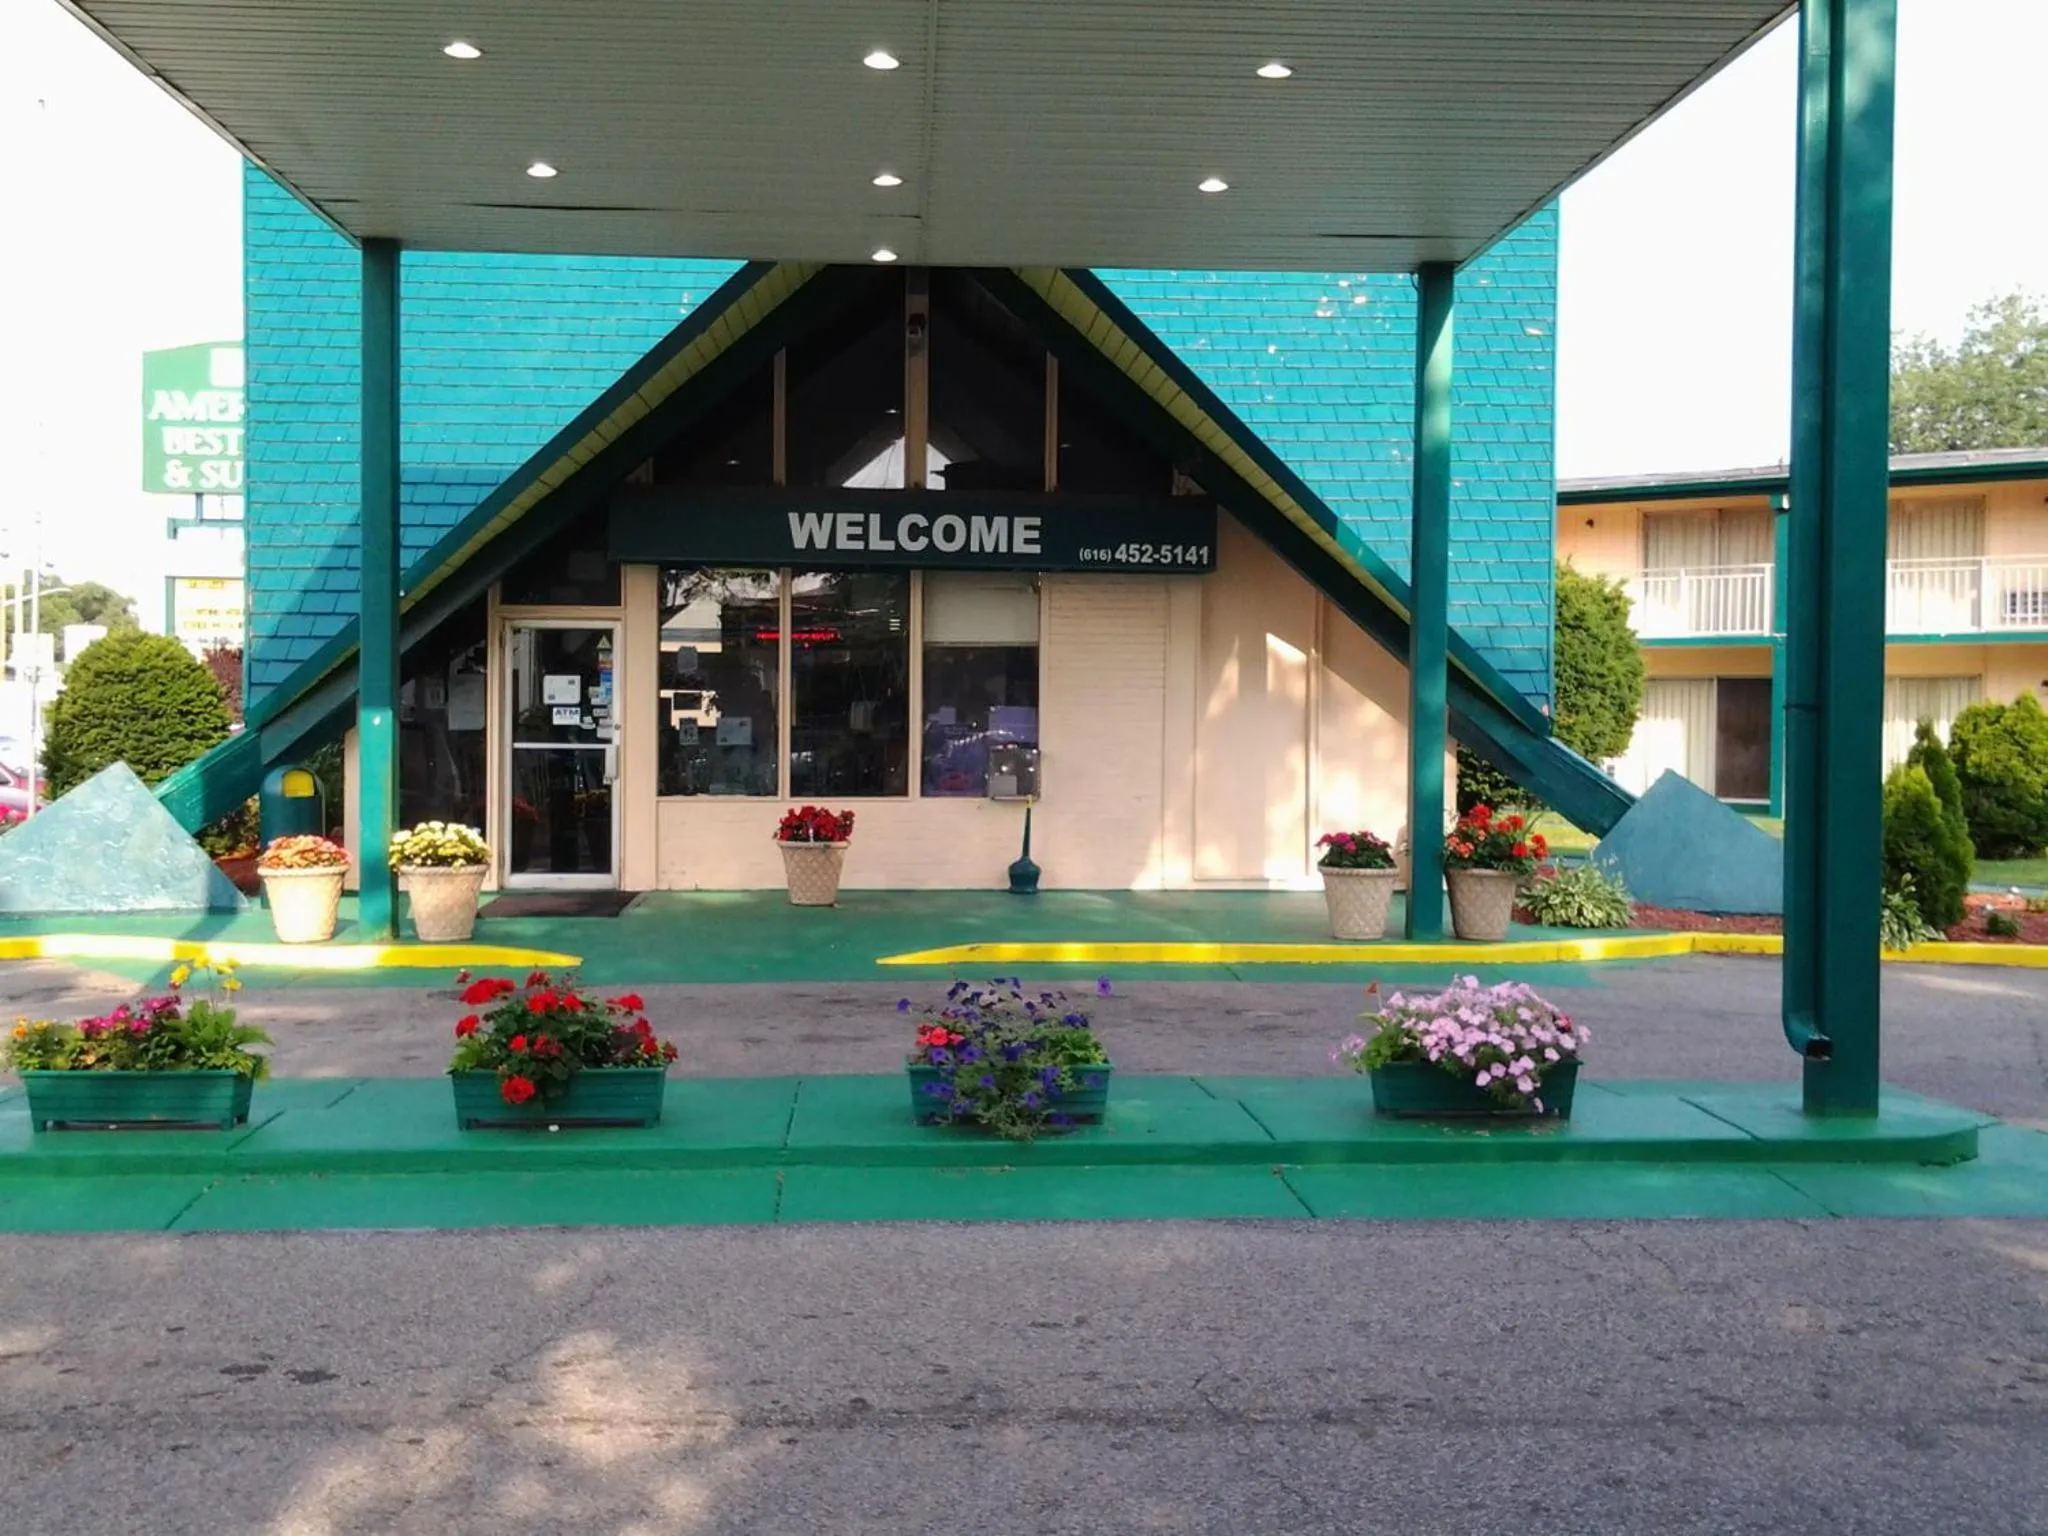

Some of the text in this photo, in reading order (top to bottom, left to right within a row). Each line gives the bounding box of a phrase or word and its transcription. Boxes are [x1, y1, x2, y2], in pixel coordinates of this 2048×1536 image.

[162, 426, 244, 456] BEST
[163, 459, 244, 489] & SU
[788, 512, 1042, 554] WELCOME
[1079, 544, 1209, 565] (616) 452-5141
[555, 709, 579, 717] ATM
